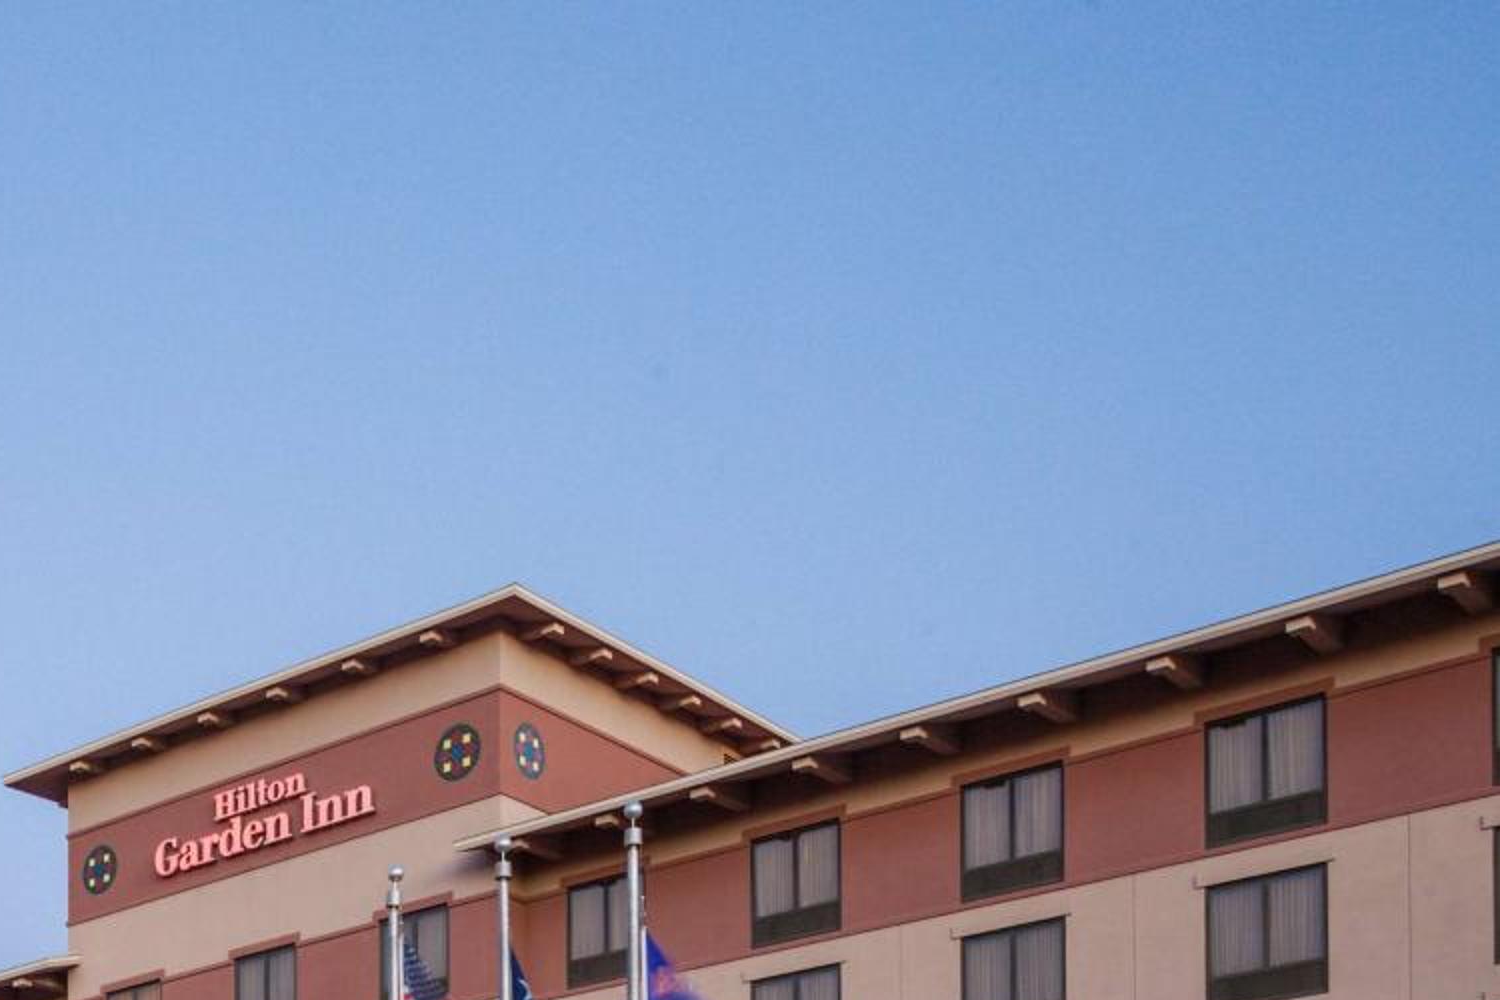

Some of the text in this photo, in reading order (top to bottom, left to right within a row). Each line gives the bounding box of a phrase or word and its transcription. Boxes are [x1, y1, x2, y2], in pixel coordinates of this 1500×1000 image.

[154, 784, 376, 877] Garden Inn
[213, 772, 307, 821] Hilton
